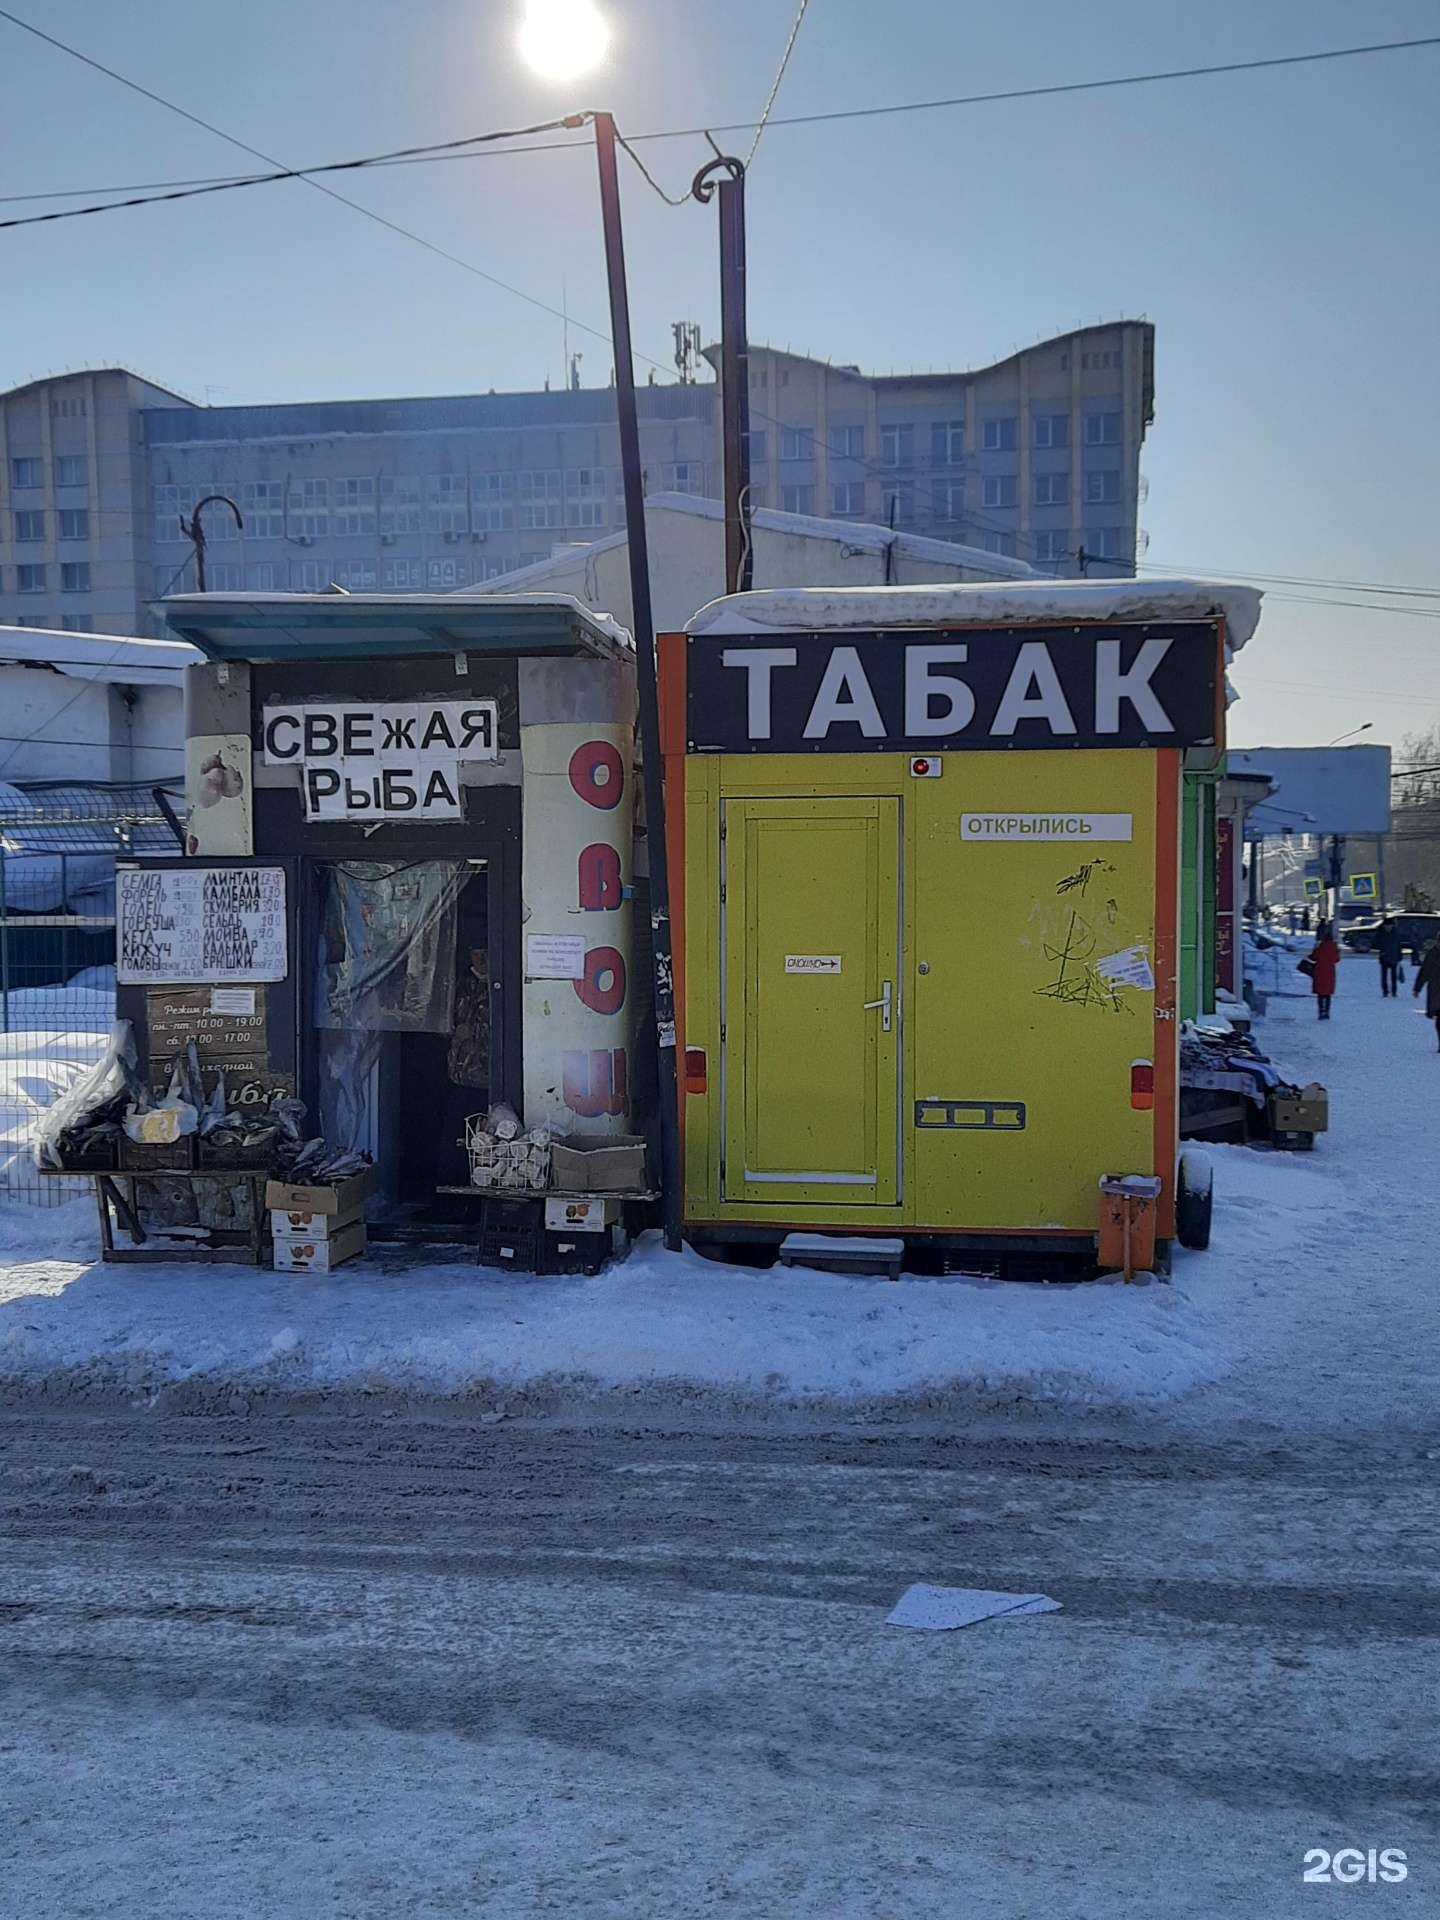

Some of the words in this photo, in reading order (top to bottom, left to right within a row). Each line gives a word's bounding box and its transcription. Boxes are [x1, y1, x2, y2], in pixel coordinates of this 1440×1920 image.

[722, 638, 1176, 740] ТАБАК
[967, 817, 1093, 835] ОТКРЫЛИСЬ
[121, 888, 168, 905] ФОРЕЛЬ
[203, 886, 261, 900] КАМБАЛА
[203, 899, 260, 914] СКУМБРИЯ
[122, 915, 175, 931] ГОРБУША
[202, 913, 242, 929] СЕЛЬДЬ
[122, 929, 154, 944] КЕТА
[122, 942, 172, 958] КИЖУЧ
[203, 940, 258, 956] КАЛЬМАР
[121, 957, 161, 971] ГОЛОВЫ
[203, 955, 253, 970] БРЮШКИ
[164, 1004, 201, 1015] Режим
